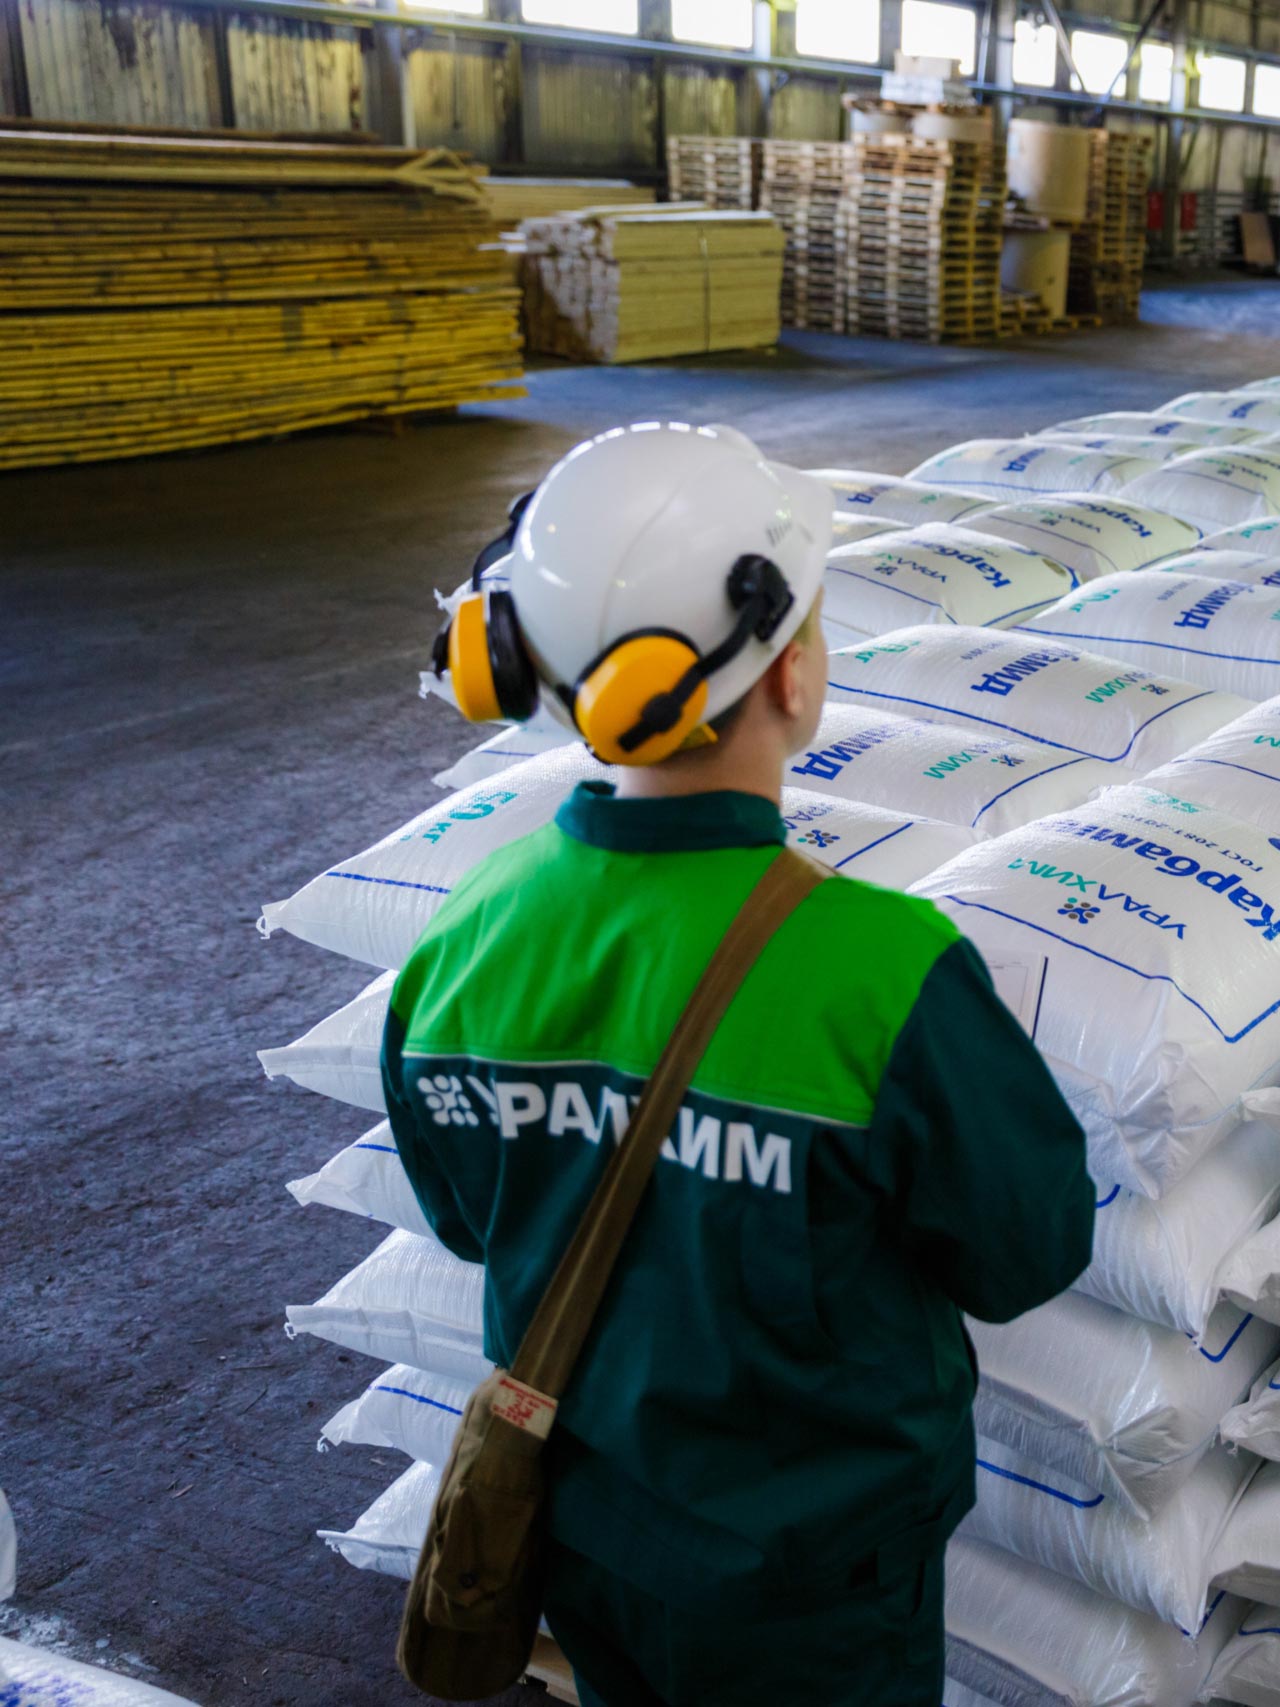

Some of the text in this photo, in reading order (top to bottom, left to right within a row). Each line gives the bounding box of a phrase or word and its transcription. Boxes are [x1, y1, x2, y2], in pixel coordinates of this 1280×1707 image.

[422, 821, 454, 844] кг
[1218, 848, 1264, 873] ГОСТ
[1008, 857, 1188, 940] УРАЛХИМ
